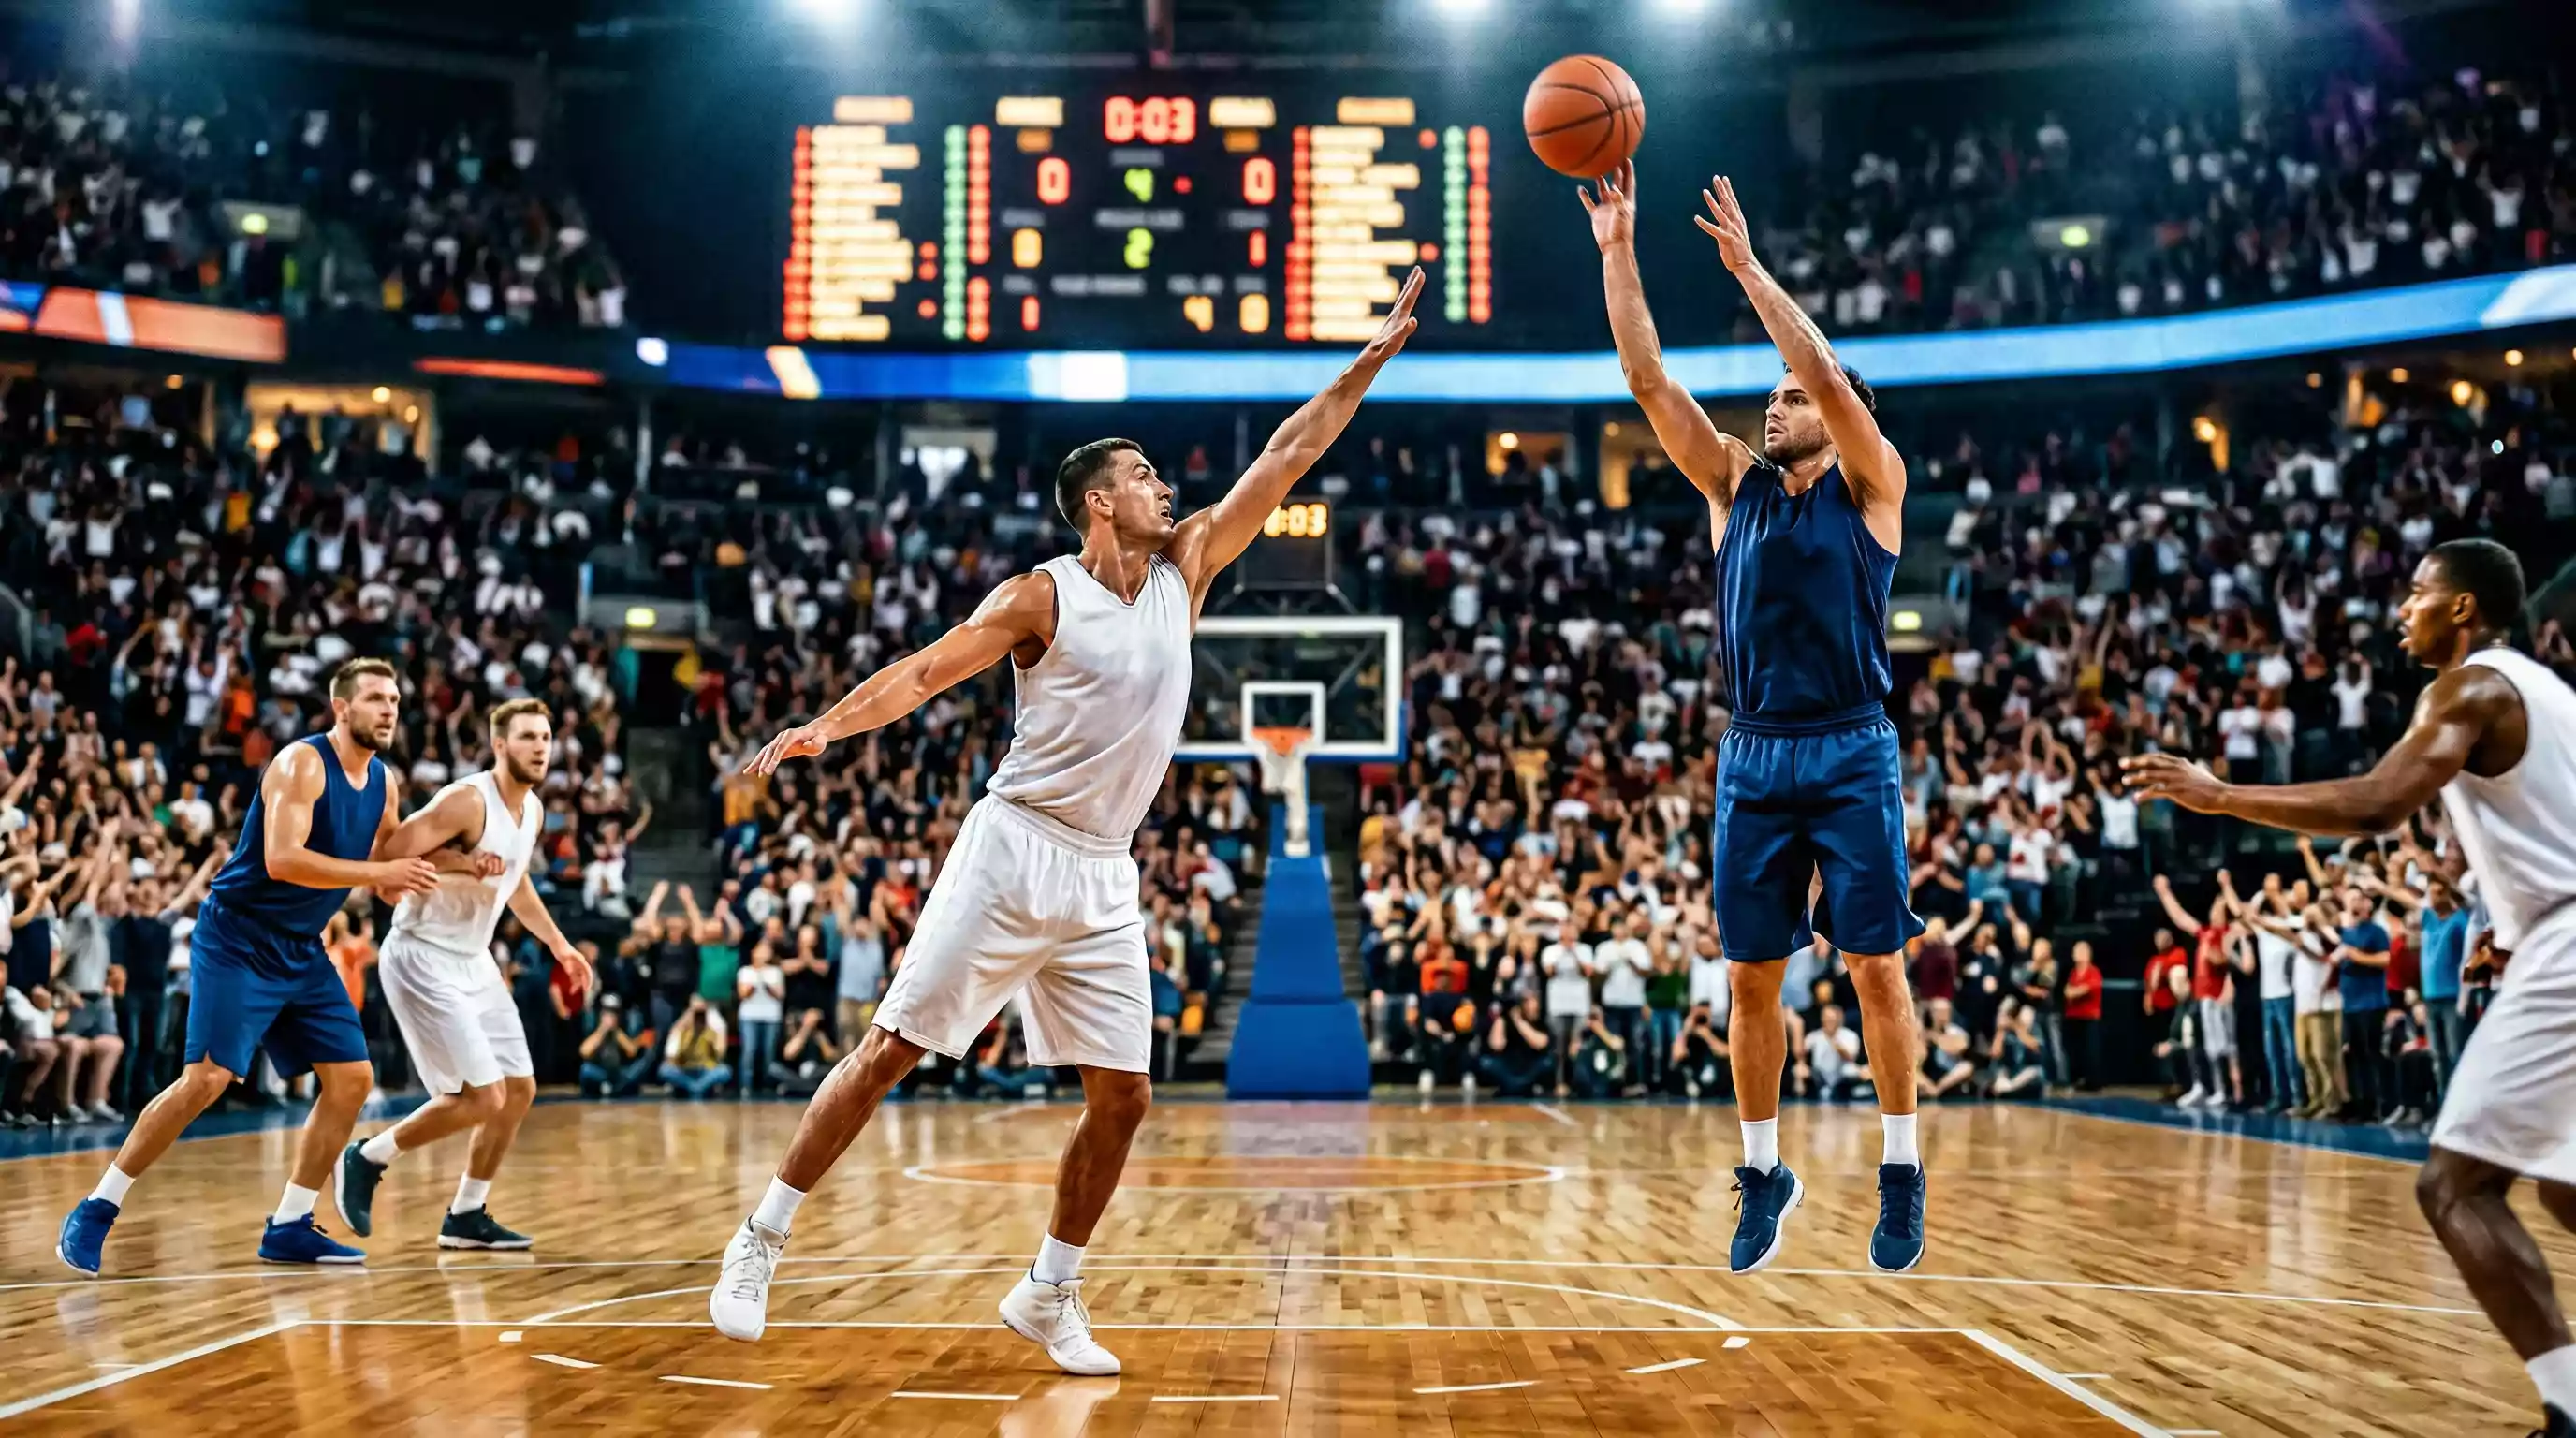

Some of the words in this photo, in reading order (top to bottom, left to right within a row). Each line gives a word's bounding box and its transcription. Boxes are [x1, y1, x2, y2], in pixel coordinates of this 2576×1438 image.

[1105, 95, 1197, 142] 0:03
[1037, 157, 1071, 204] 0
[1243, 157, 1276, 204] 0
